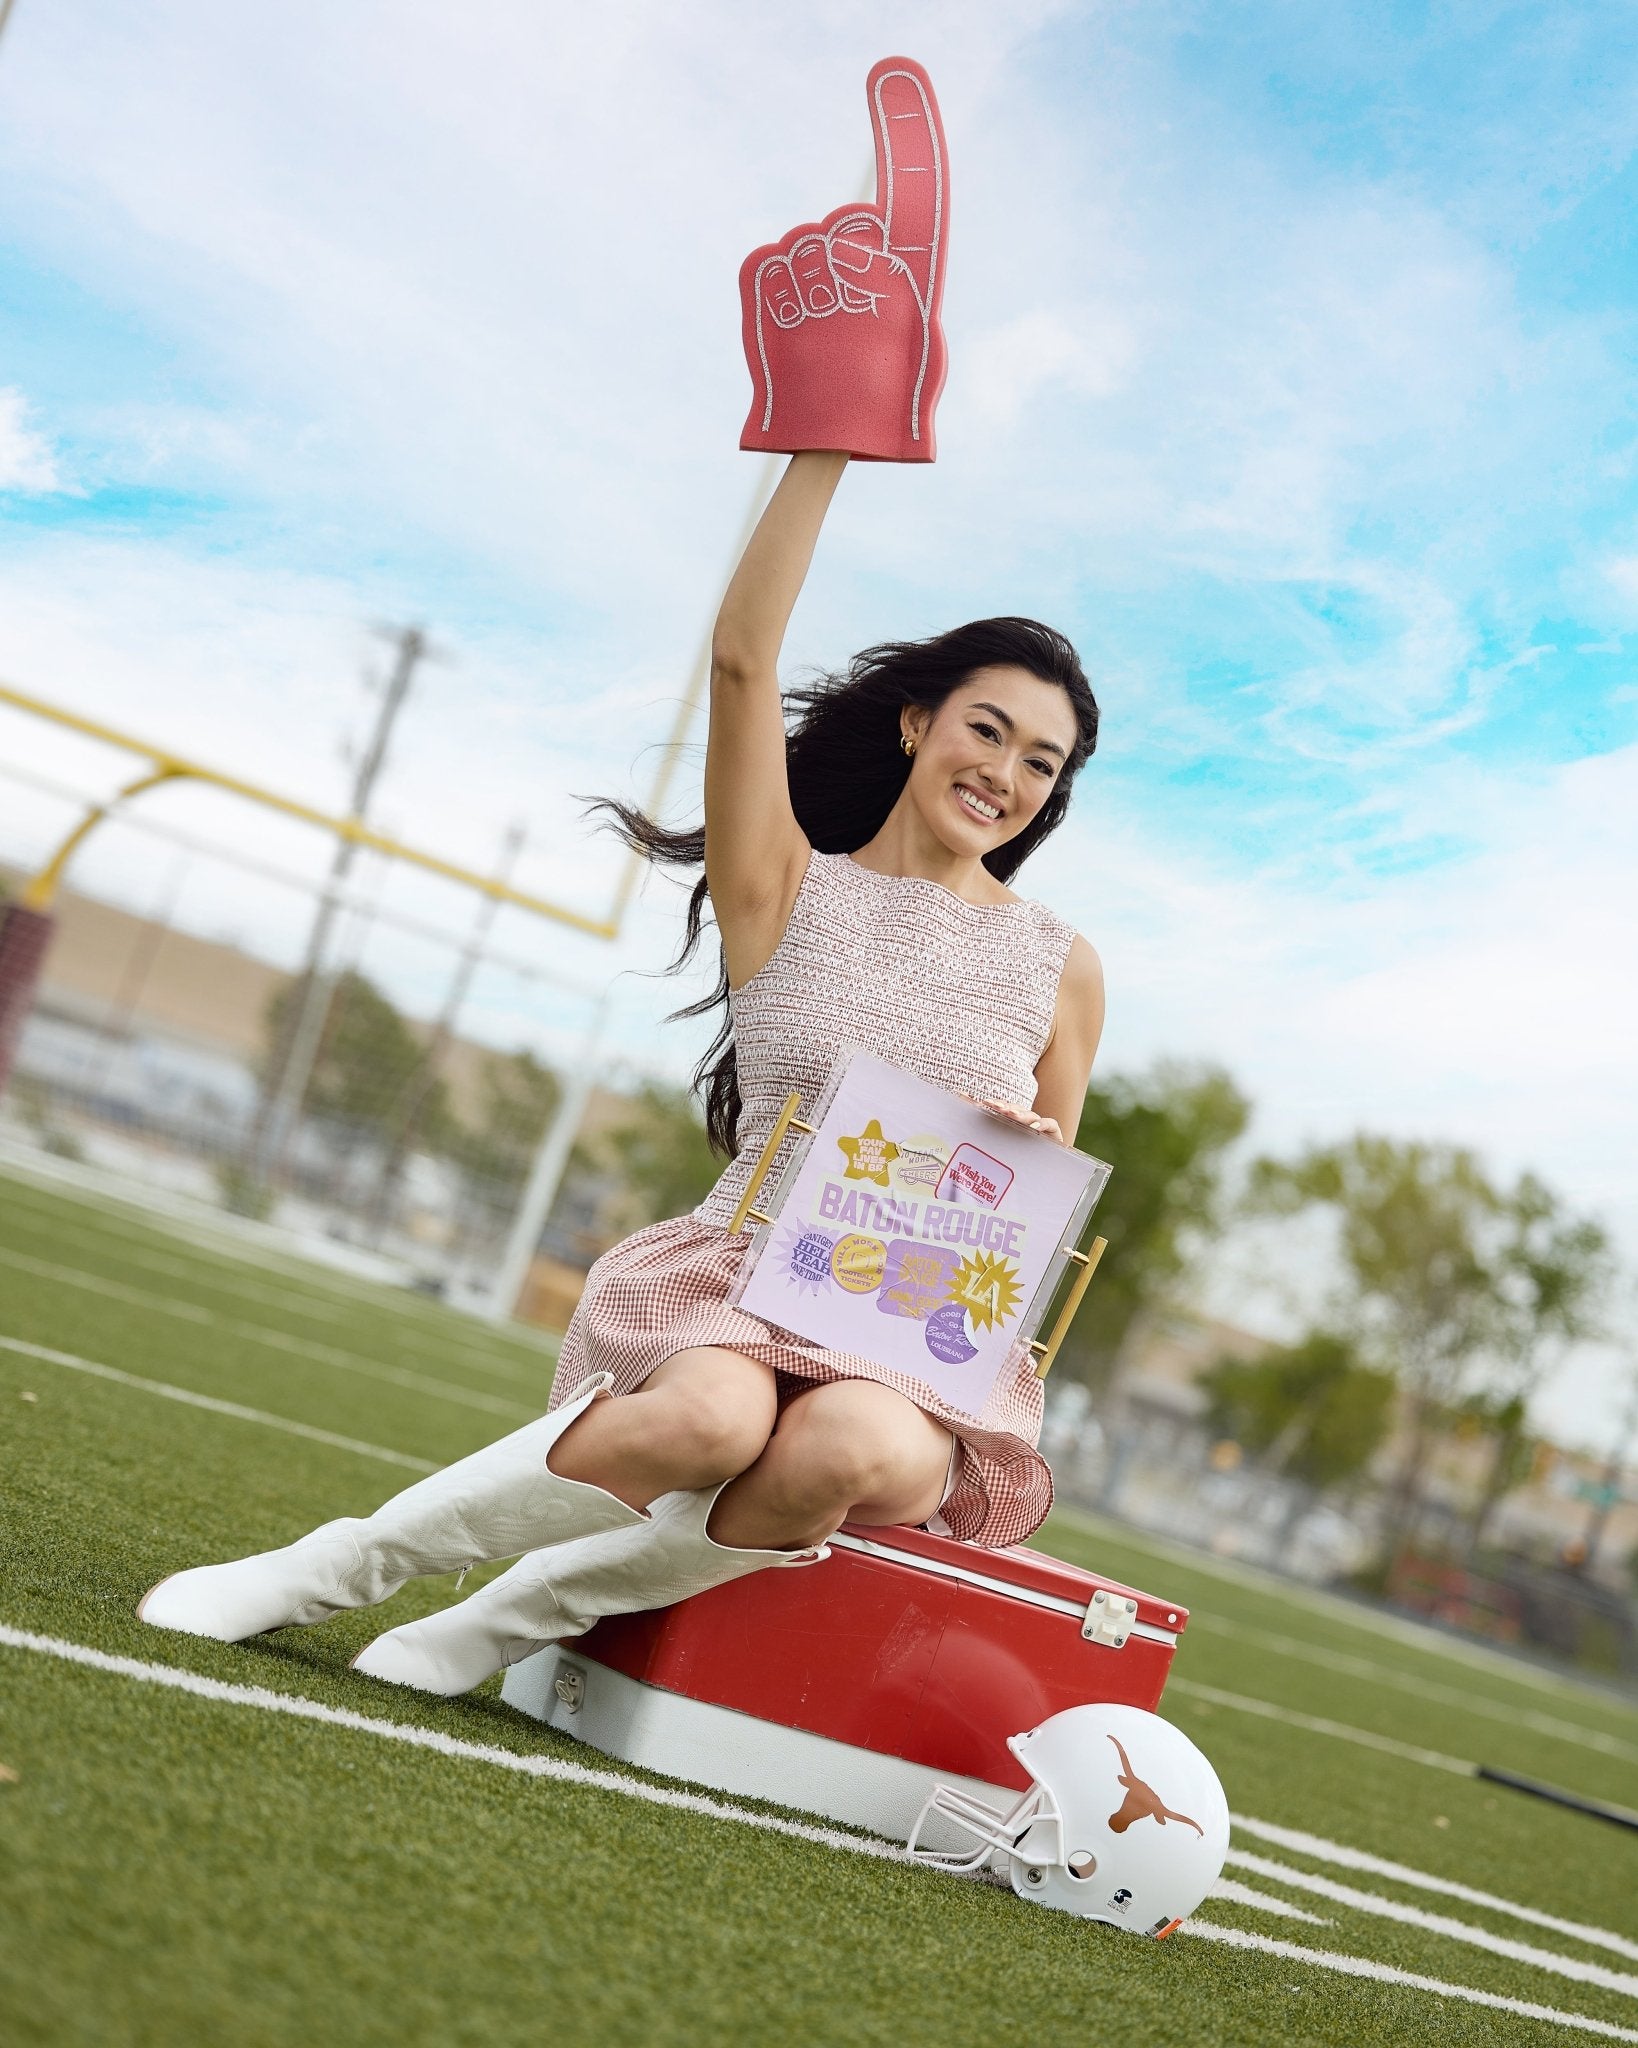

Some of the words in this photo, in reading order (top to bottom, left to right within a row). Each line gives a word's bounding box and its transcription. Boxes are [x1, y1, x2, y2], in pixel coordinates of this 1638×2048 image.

[858, 1138, 886, 1148] YOUR
[860, 1146, 883, 1155] FAV
[853, 1153, 886, 1164] LIVES
[854, 1160, 865, 1170] IN
[868, 1163, 884, 1172] BR
[909, 1156, 930, 1164] MORE
[903, 1171, 937, 1180] CHEERS
[957, 1162, 980, 1183] Wish
[980, 1175, 997, 1193] You
[949, 1168, 972, 1188] Were
[970, 1182, 997, 1204] Here!
[819, 1181, 919, 1237] BATON
[921, 1204, 1026, 1258] ROUGE
[803, 1232, 819, 1241] CAN
[820, 1236, 834, 1249] GET
[836, 1245, 850, 1266] WILL
[852, 1239, 879, 1252] WORK
[792, 1247, 831, 1276] YEAH
[790, 1262, 806, 1277] ONE
[804, 1268, 825, 1281] TIME
[838, 1267, 876, 1281] FOOTBALL
[841, 1275, 871, 1287] TICKETS
[930, 1340, 964, 1360] LOUISIANA
